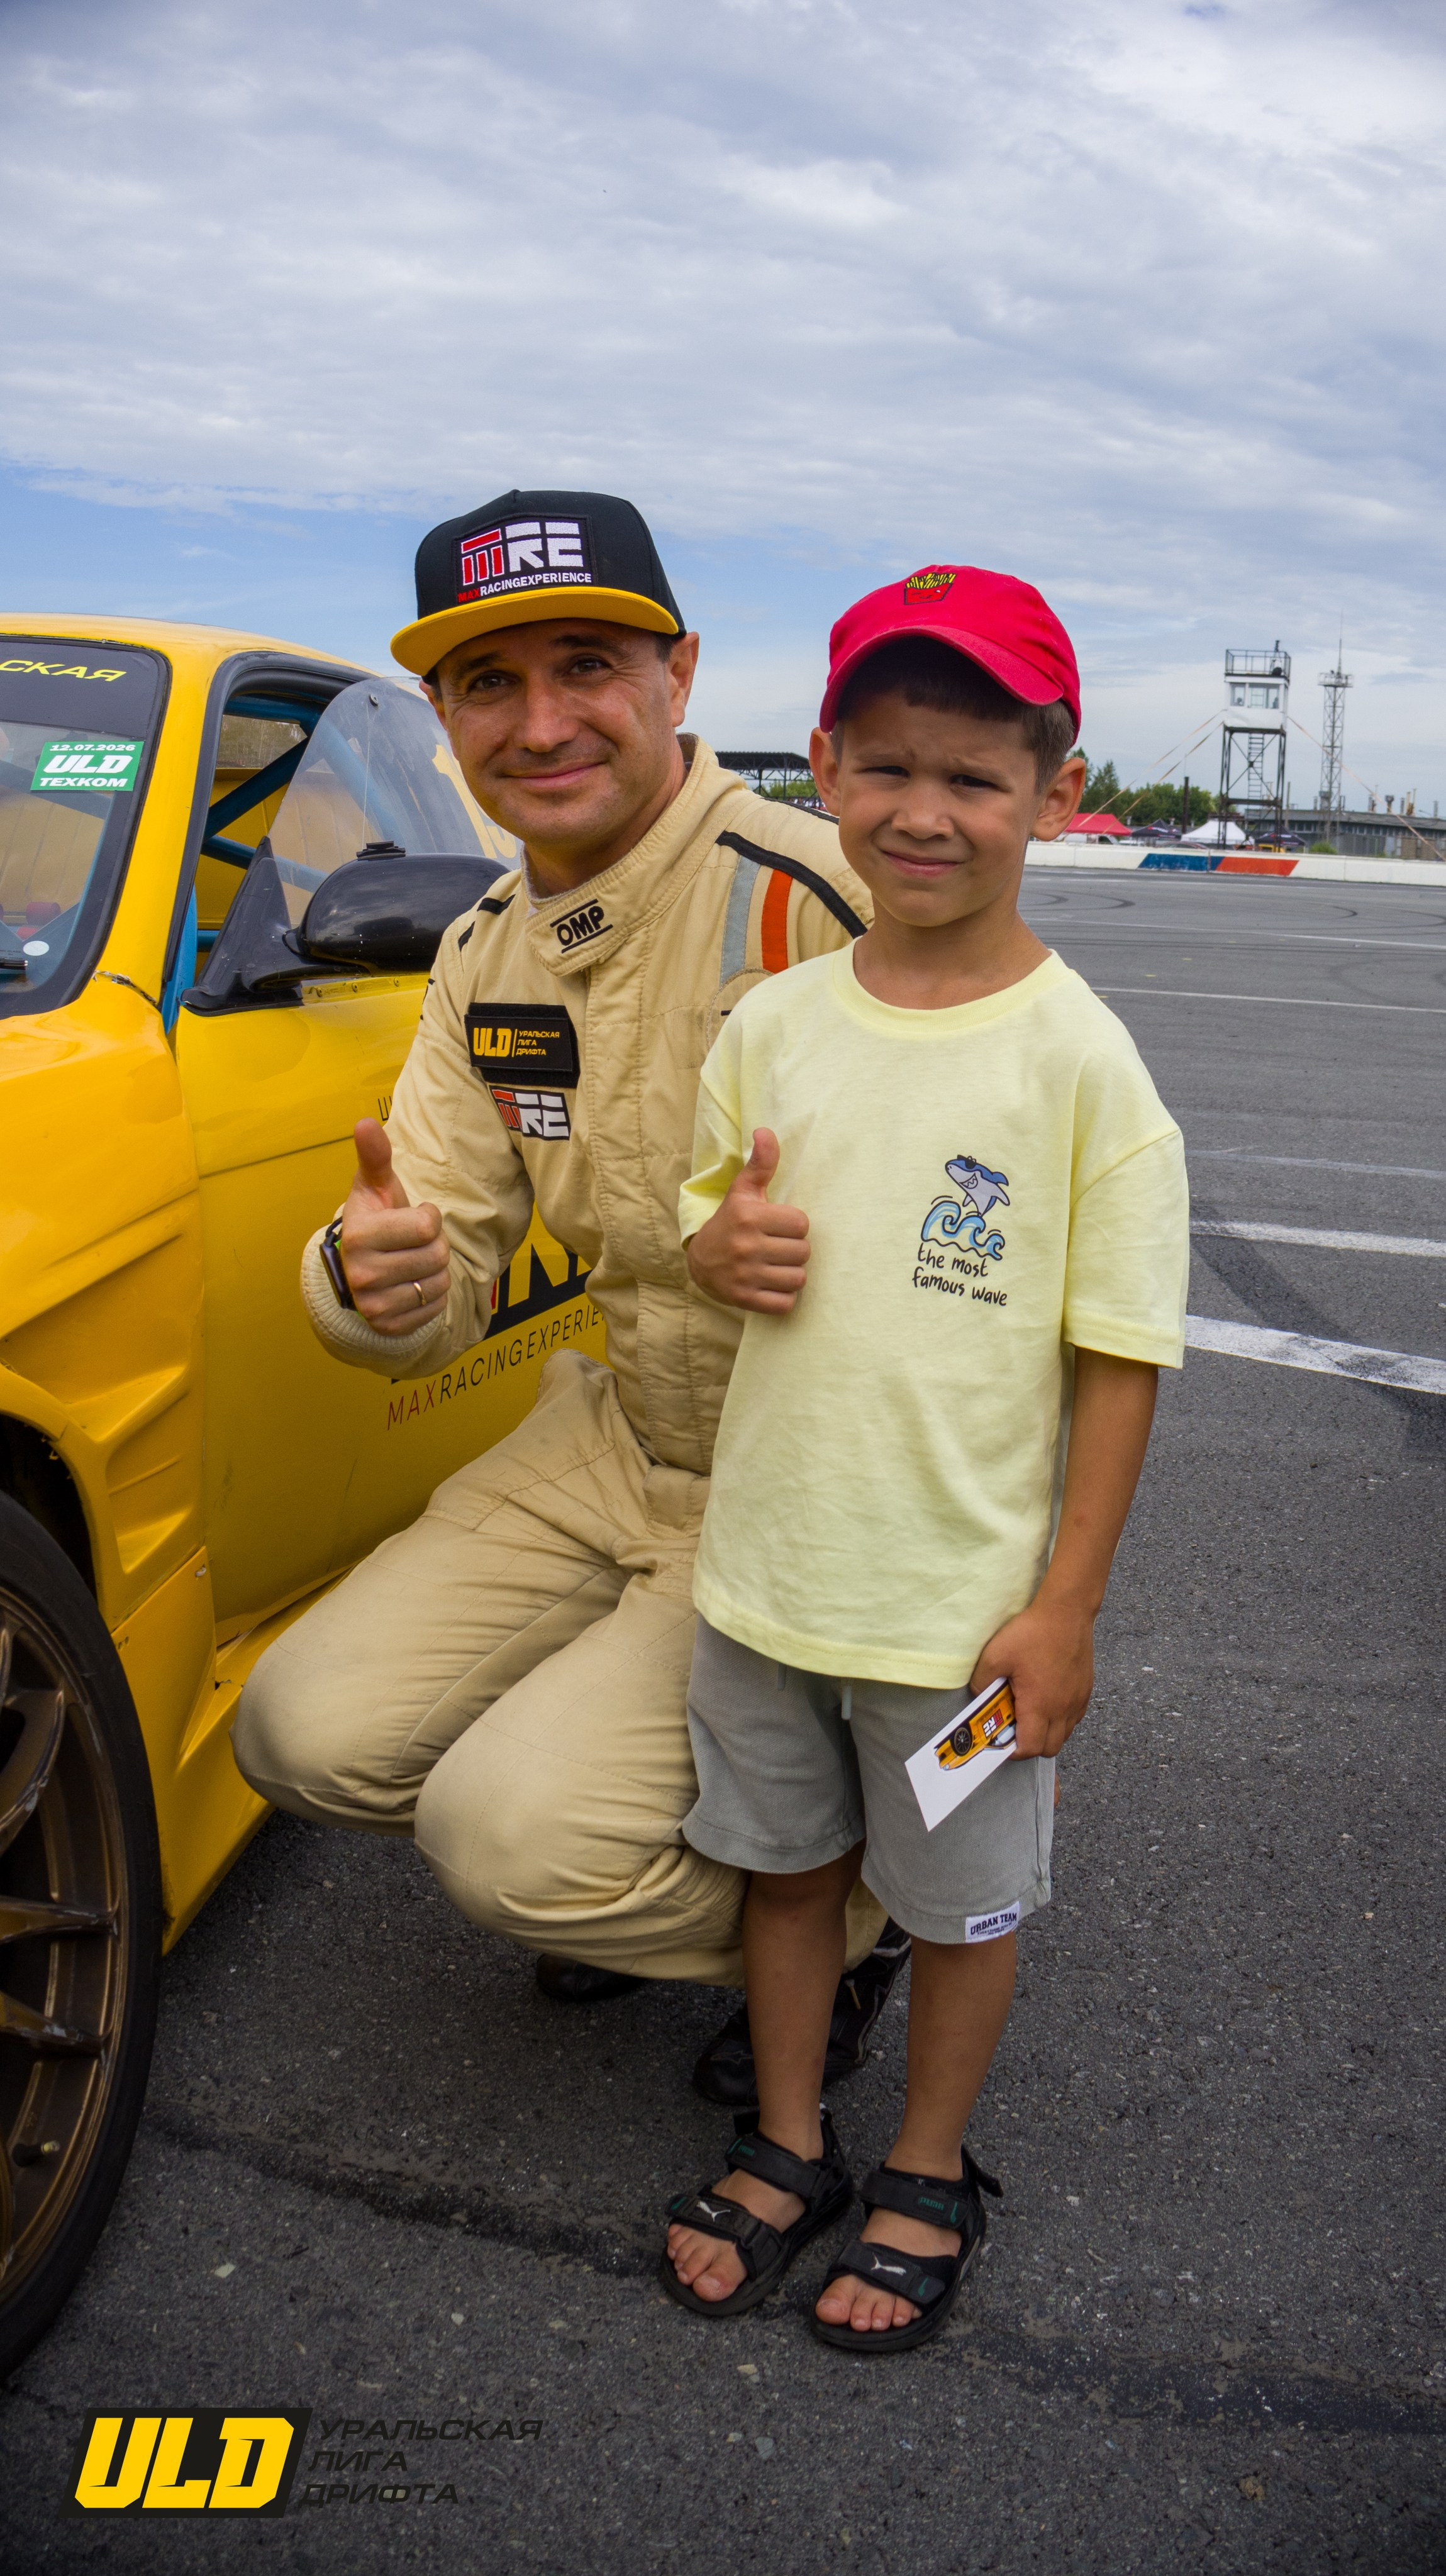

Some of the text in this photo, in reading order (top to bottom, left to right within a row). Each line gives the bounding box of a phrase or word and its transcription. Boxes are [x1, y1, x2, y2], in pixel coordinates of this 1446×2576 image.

[43, 755, 133, 774] ULD
[40, 777, 128, 787] ТЕХКОМ
[557, 906, 604, 946] OMP
[473, 1027, 512, 1057] ULD
[918, 1243, 988, 1277] the most
[912, 1267, 1008, 1306] famous wave
[387, 1305, 604, 1430] MAXRACINGEXPERIE
[970, 1916, 998, 1935] URBAN
[999, 1913, 1017, 1923] TEAM
